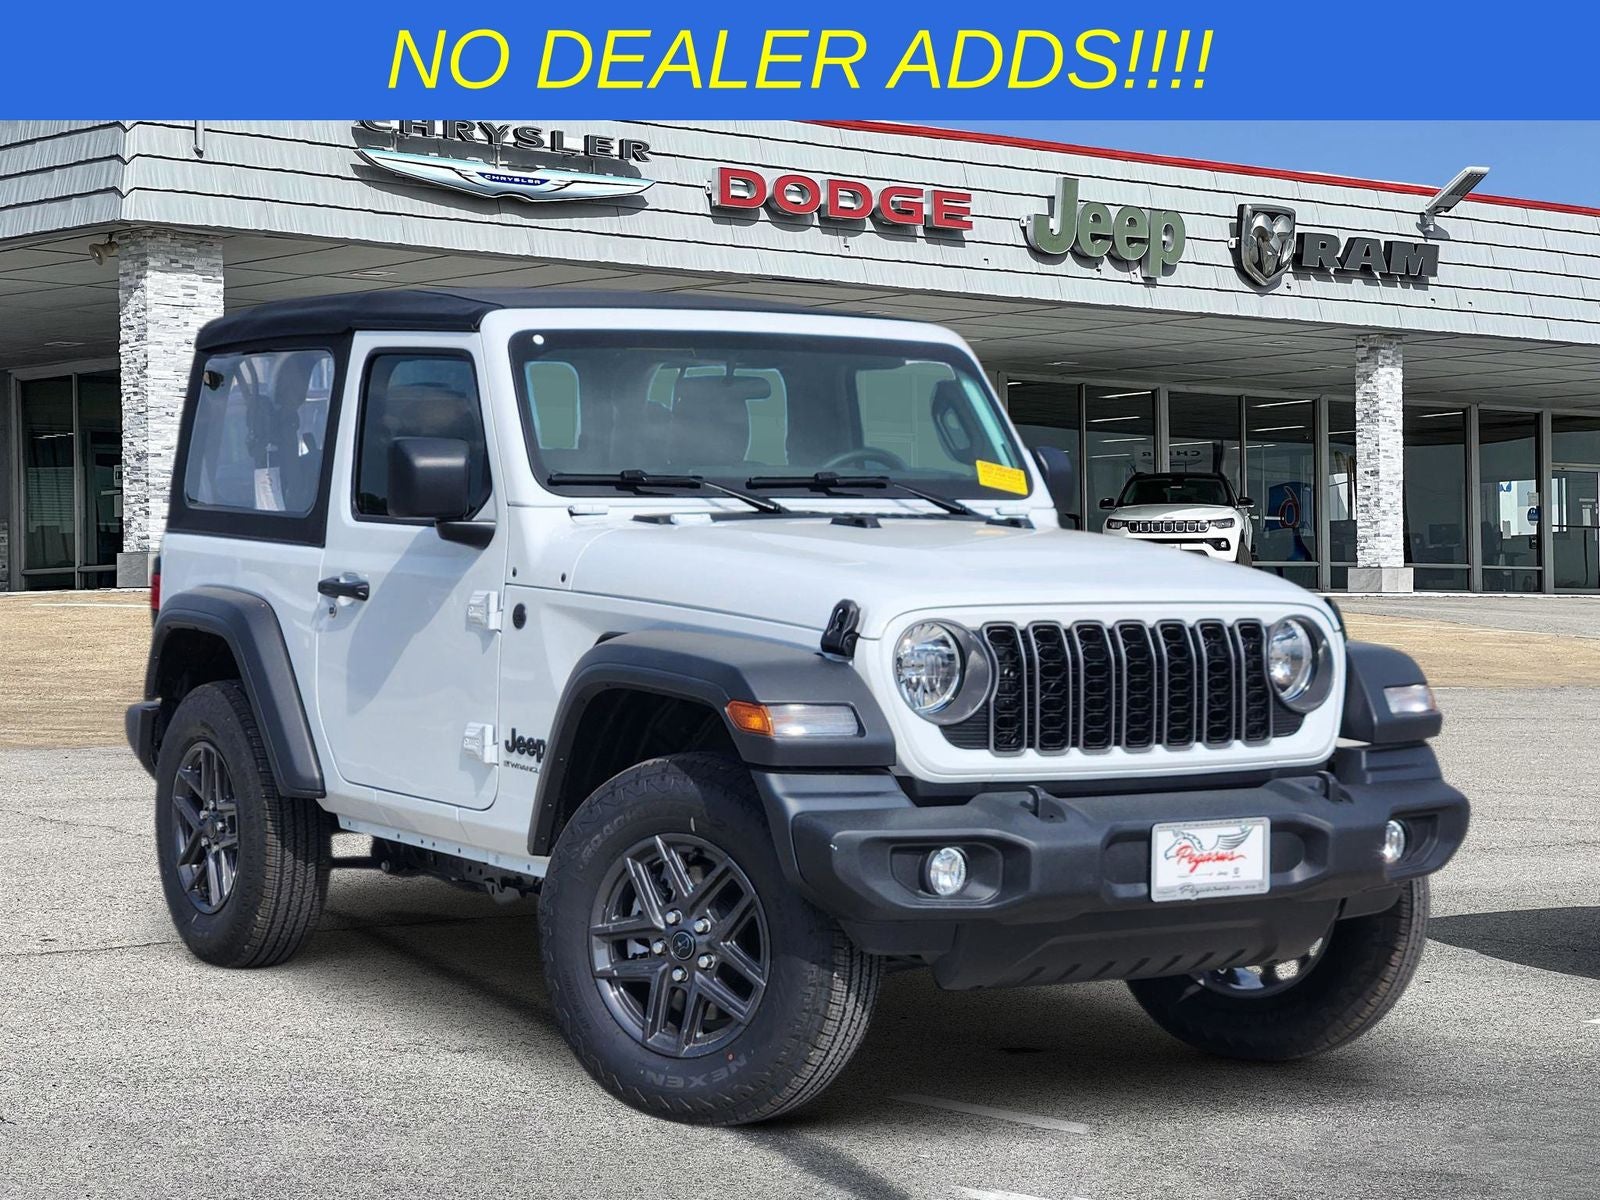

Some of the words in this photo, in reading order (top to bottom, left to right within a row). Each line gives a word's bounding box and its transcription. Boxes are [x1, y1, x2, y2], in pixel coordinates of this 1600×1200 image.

[484, 174, 541, 185] CHRYSLER
[712, 167, 973, 231] DODGE
[1028, 177, 1186, 278] Jeep
[1297, 232, 1440, 277] RAM
[504, 727, 546, 763] Jeep
